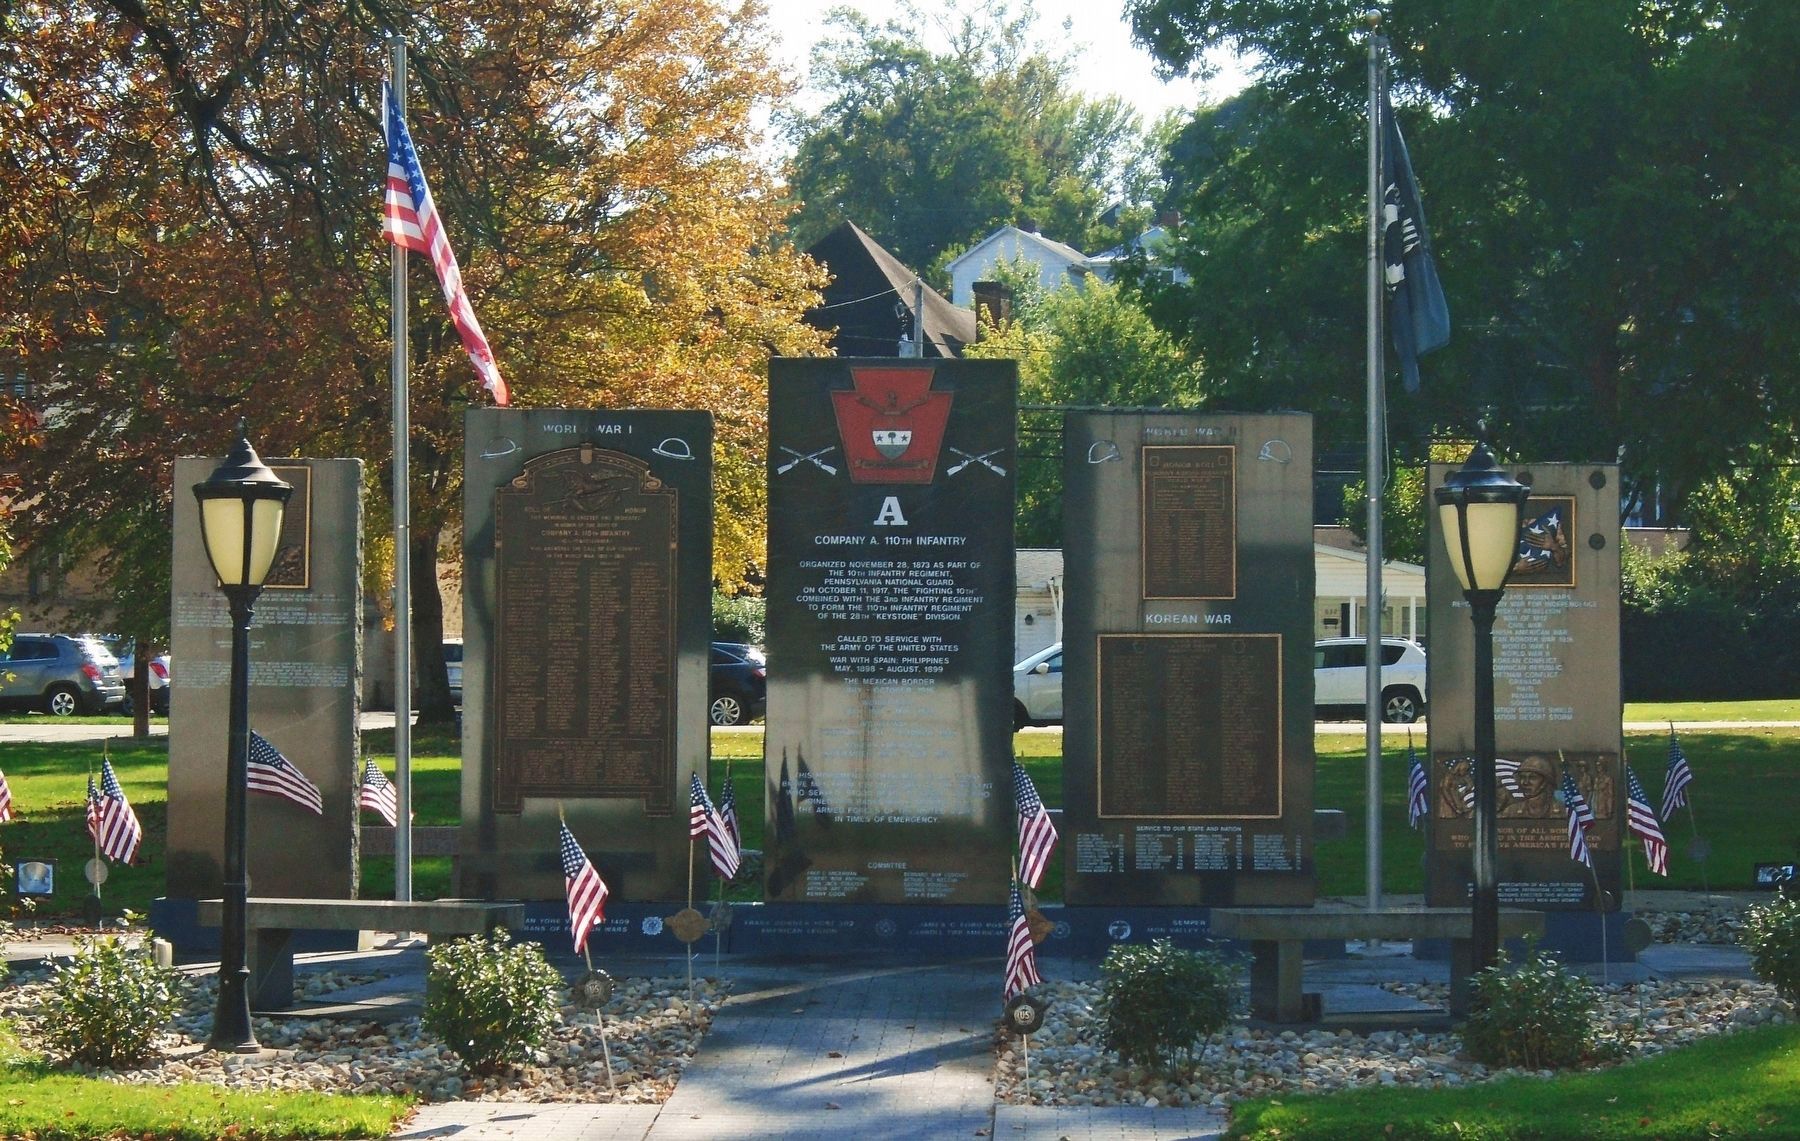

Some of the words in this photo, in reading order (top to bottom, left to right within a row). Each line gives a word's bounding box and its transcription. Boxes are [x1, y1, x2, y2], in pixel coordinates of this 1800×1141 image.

[628, 425, 632, 434] I
[873, 496, 908, 526] A
[815, 536, 865, 545] COMPANY
[884, 536, 912, 545] 110TH
[916, 536, 966, 545] INFANTRY
[1145, 614, 1198, 624] KOREAN
[1204, 614, 1232, 624] WAR
